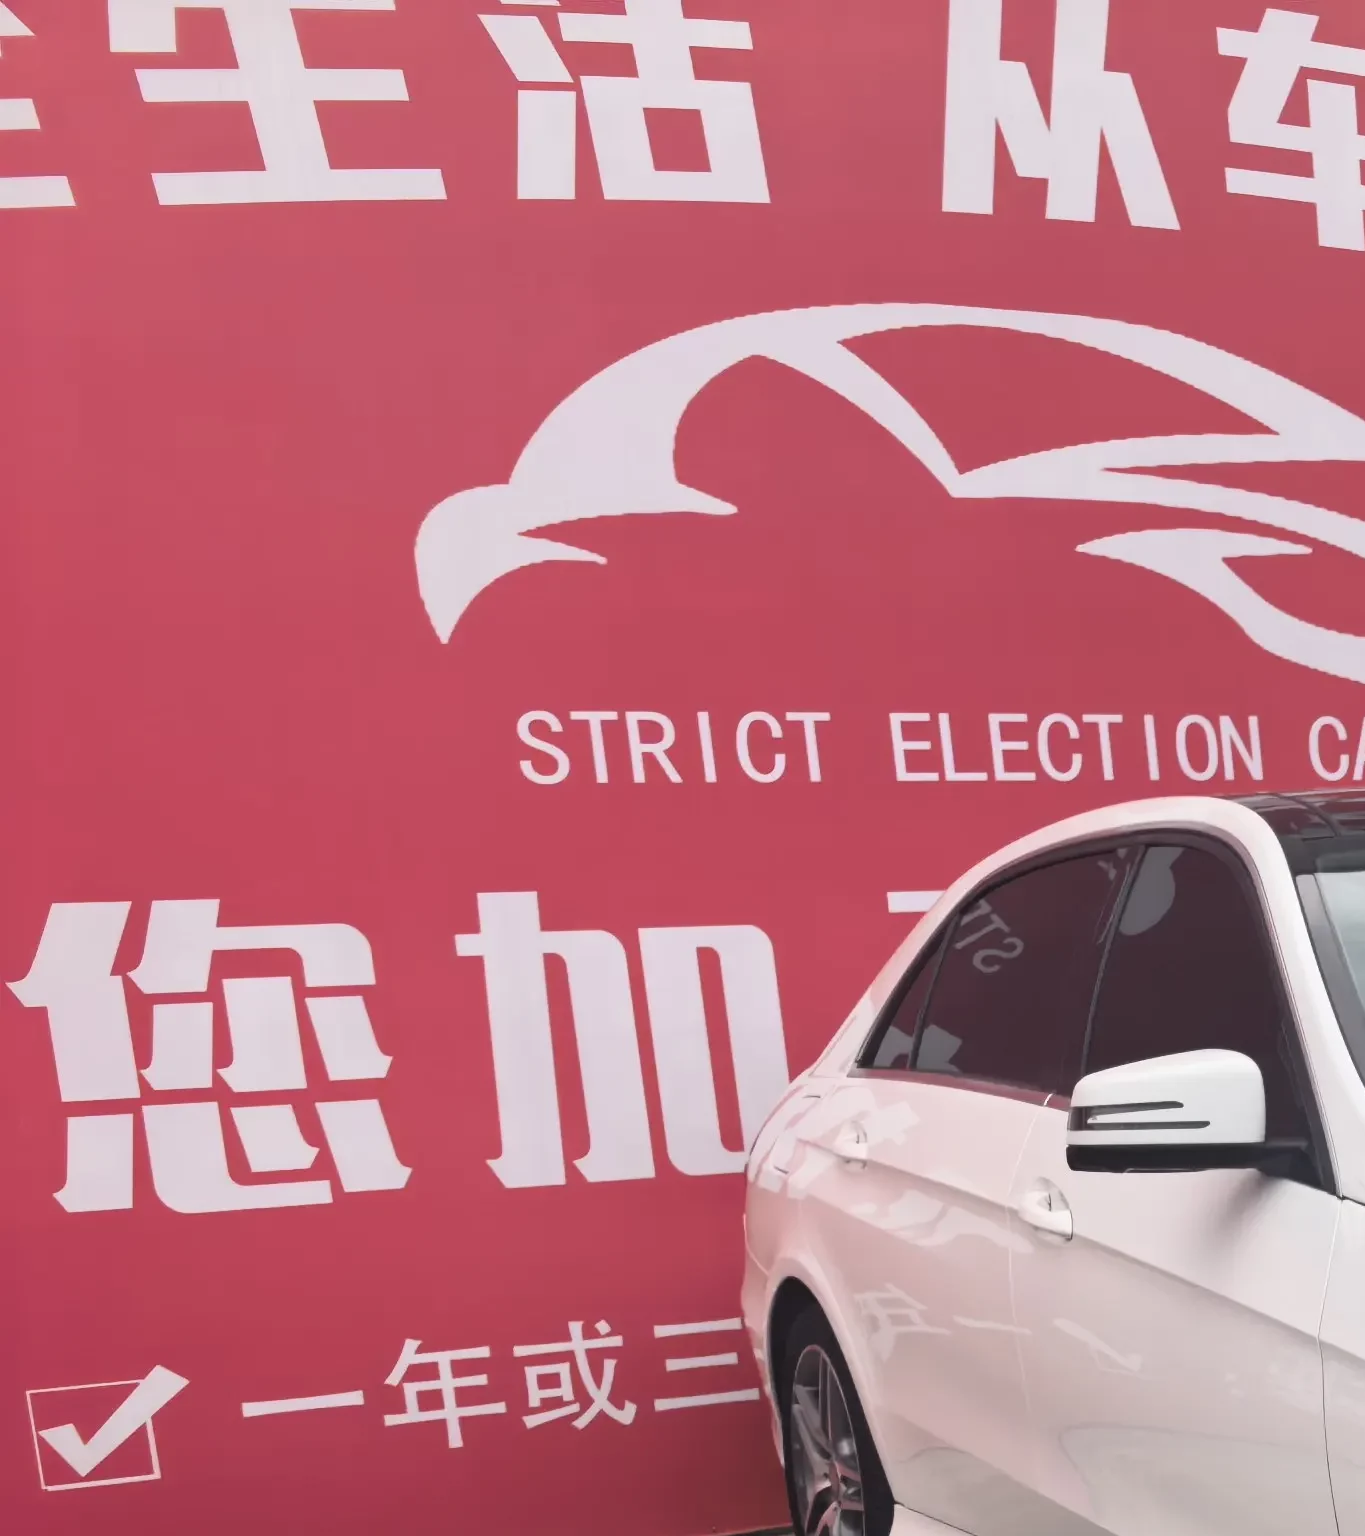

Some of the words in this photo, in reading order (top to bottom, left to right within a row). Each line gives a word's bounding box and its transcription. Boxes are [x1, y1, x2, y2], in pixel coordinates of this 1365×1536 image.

[0, 0, 771, 207] 生活
[516, 710, 831, 784] STRICT
[889, 712, 1264, 783] ELECTION
[6, 890, 945, 1213] 您加
[242, 1318, 760, 1449] 一年或三
